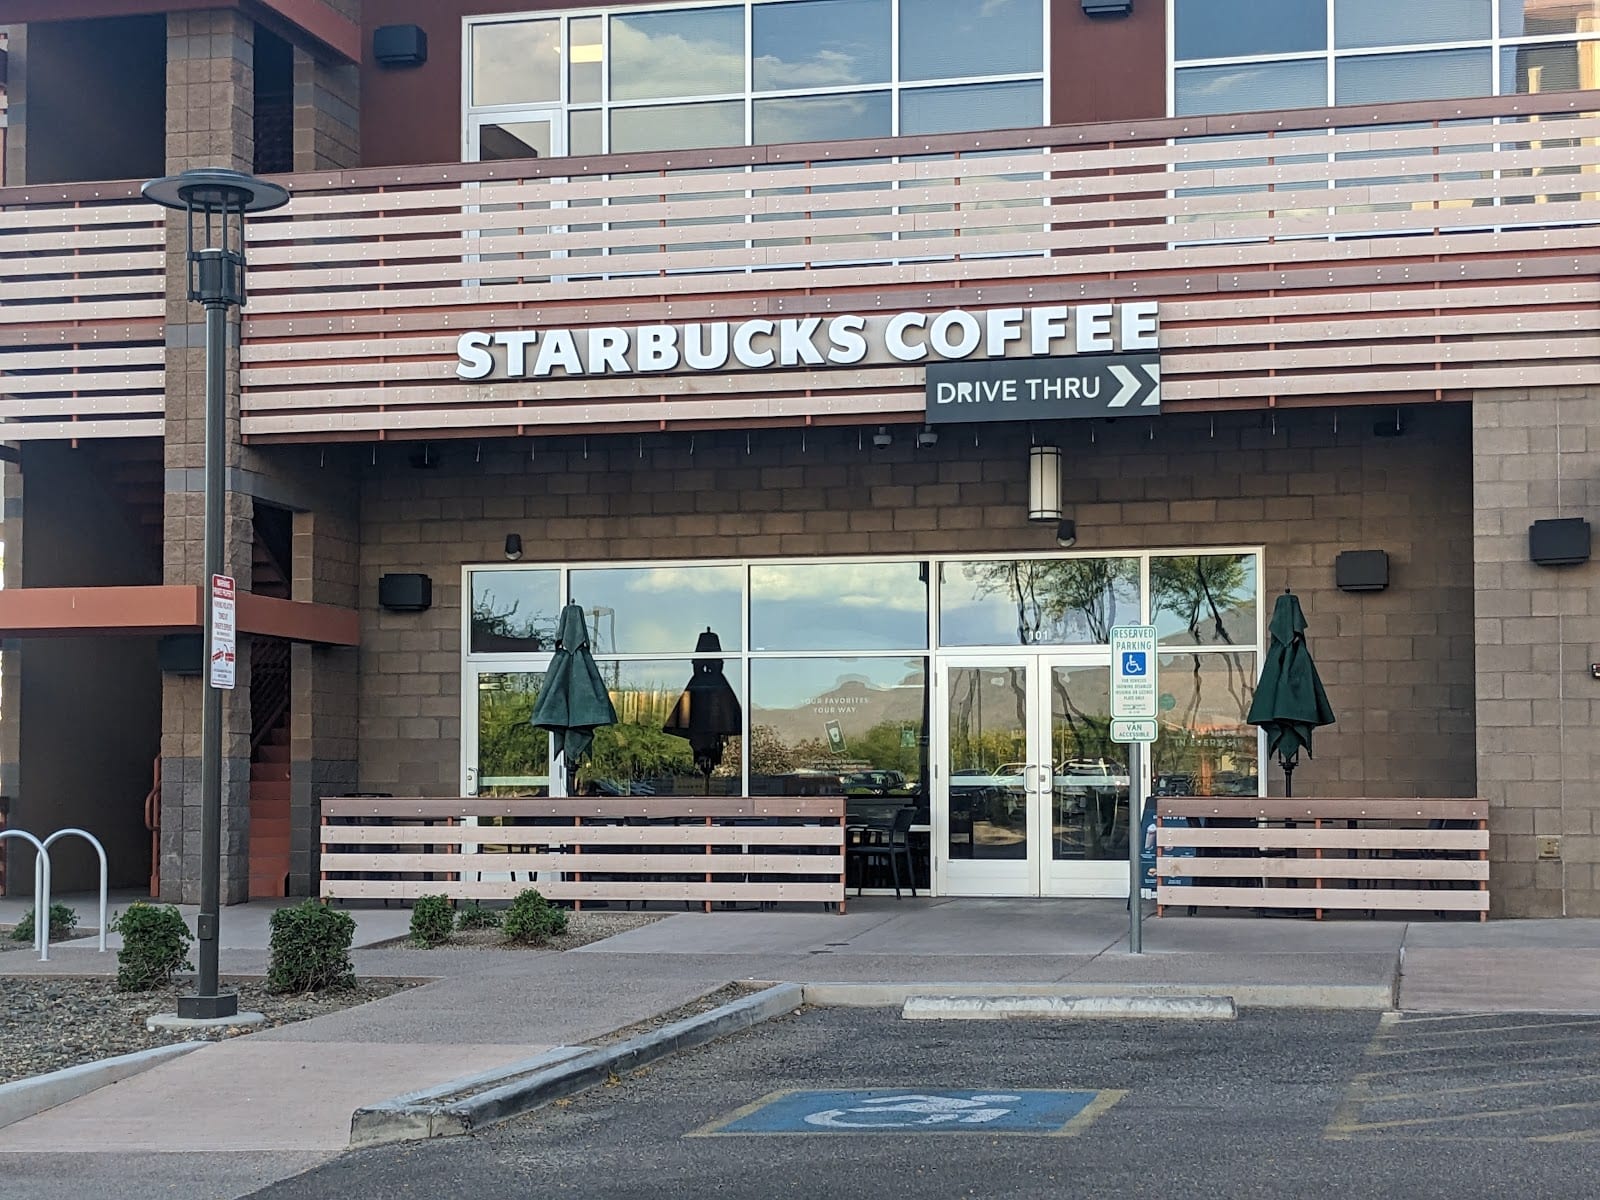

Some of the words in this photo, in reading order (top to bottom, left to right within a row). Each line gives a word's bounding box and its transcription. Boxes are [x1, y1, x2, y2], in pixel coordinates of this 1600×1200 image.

[455, 314, 867, 380] STARBUCKS
[884, 301, 1160, 362] COFFEE
[936, 379, 1017, 405] DRIVE
[1025, 375, 1101, 400] THRU
[1028, 630, 1049, 641] 101
[1113, 628, 1154, 639] RESERVED
[1116, 641, 1152, 651] PARKING
[814, 706, 835, 714] YOUR
[1126, 724, 1143, 732] VAN
